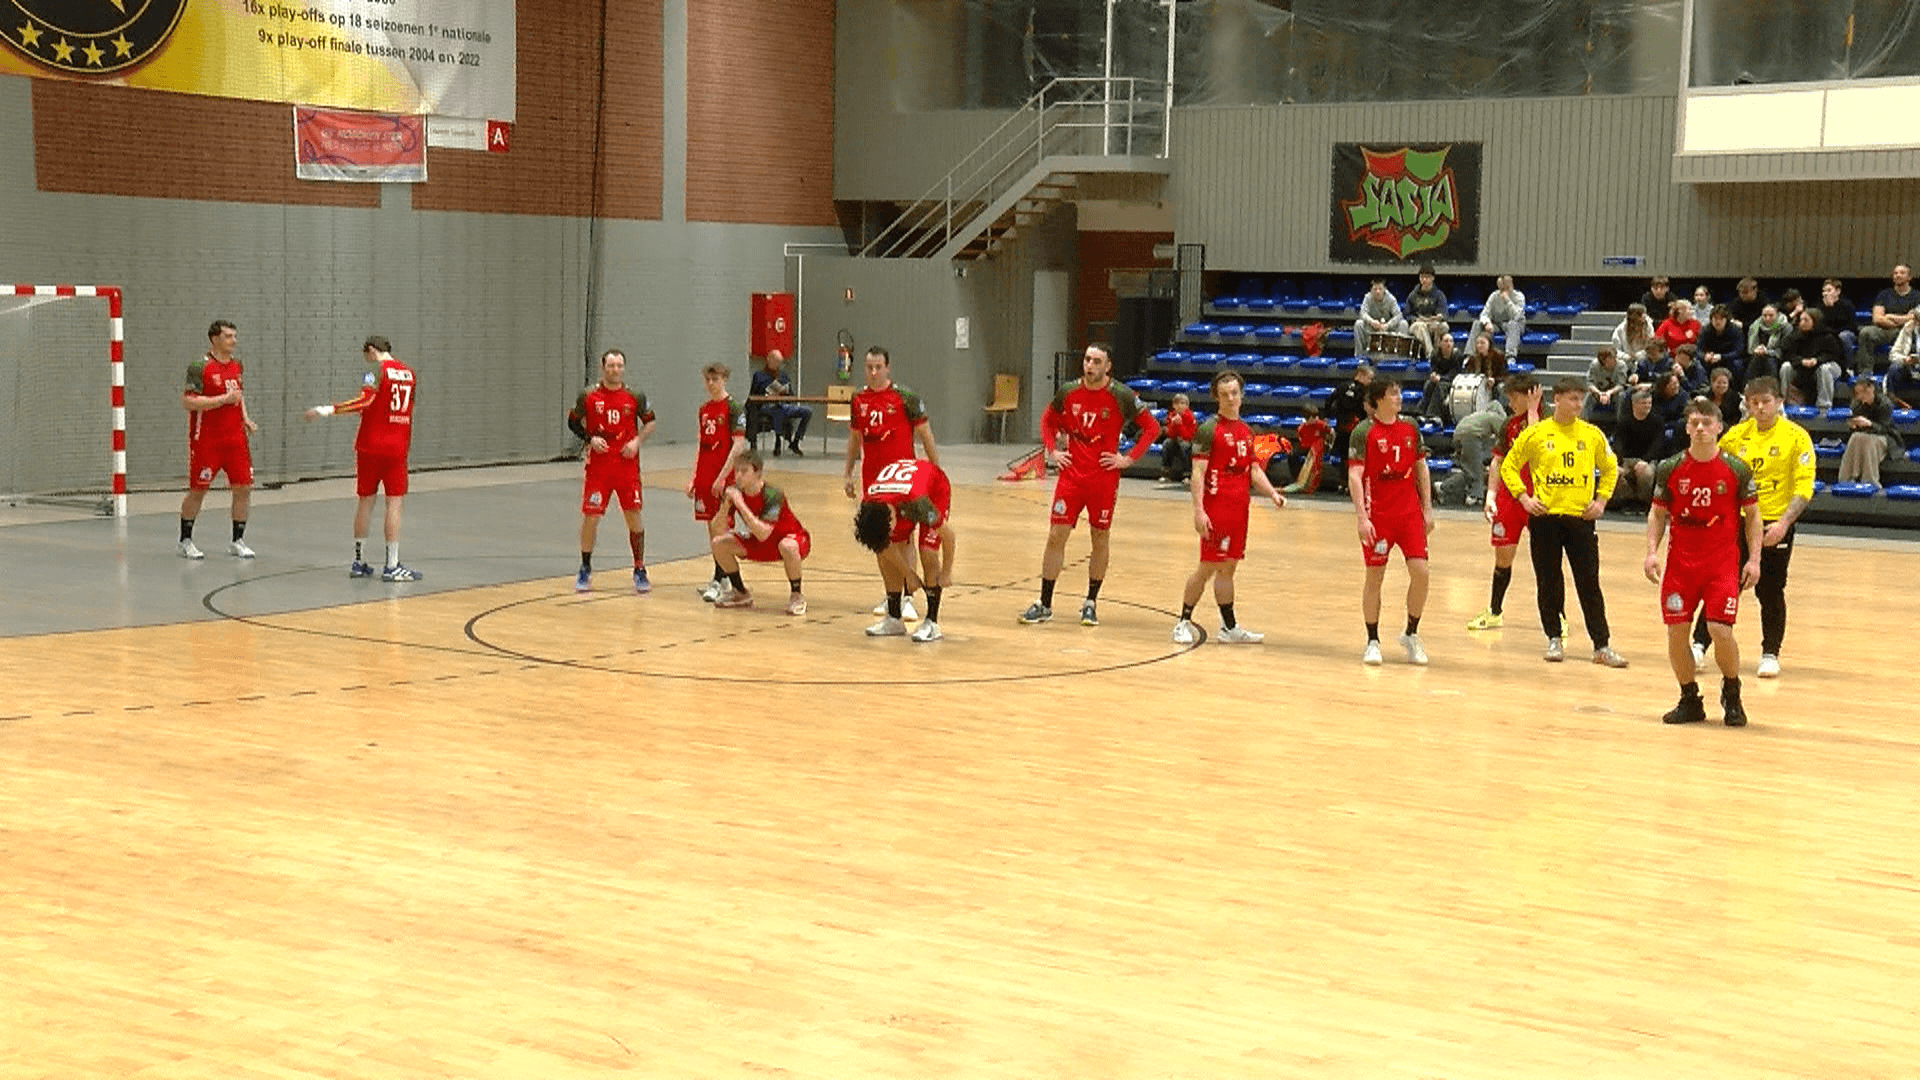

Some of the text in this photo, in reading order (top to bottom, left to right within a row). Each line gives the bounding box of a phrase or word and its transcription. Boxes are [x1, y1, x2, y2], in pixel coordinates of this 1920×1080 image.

[269, 4, 325, 23] play-offs
[329, 13, 346, 28] op
[350, 13, 362, 28] 18
[366, 18, 425, 36] seizoenen
[442, 28, 491, 44] nationale
[258, 28, 480, 67] 9x play-off finale tussen 2004 en 2022
[493, 127, 505, 146] A
[390, 383, 411, 413] 37
[607, 409, 620, 425] 19
[870, 410, 883, 427] 21
[1083, 411, 1097, 428] 17
[1236, 440, 1247, 457] 15
[1392, 445, 1400, 463] 7
[1562, 451, 1574, 468] 16
[1751, 457, 1764, 473] 12
[876, 463, 918, 482] 20
[1692, 487, 1712, 507] 23
